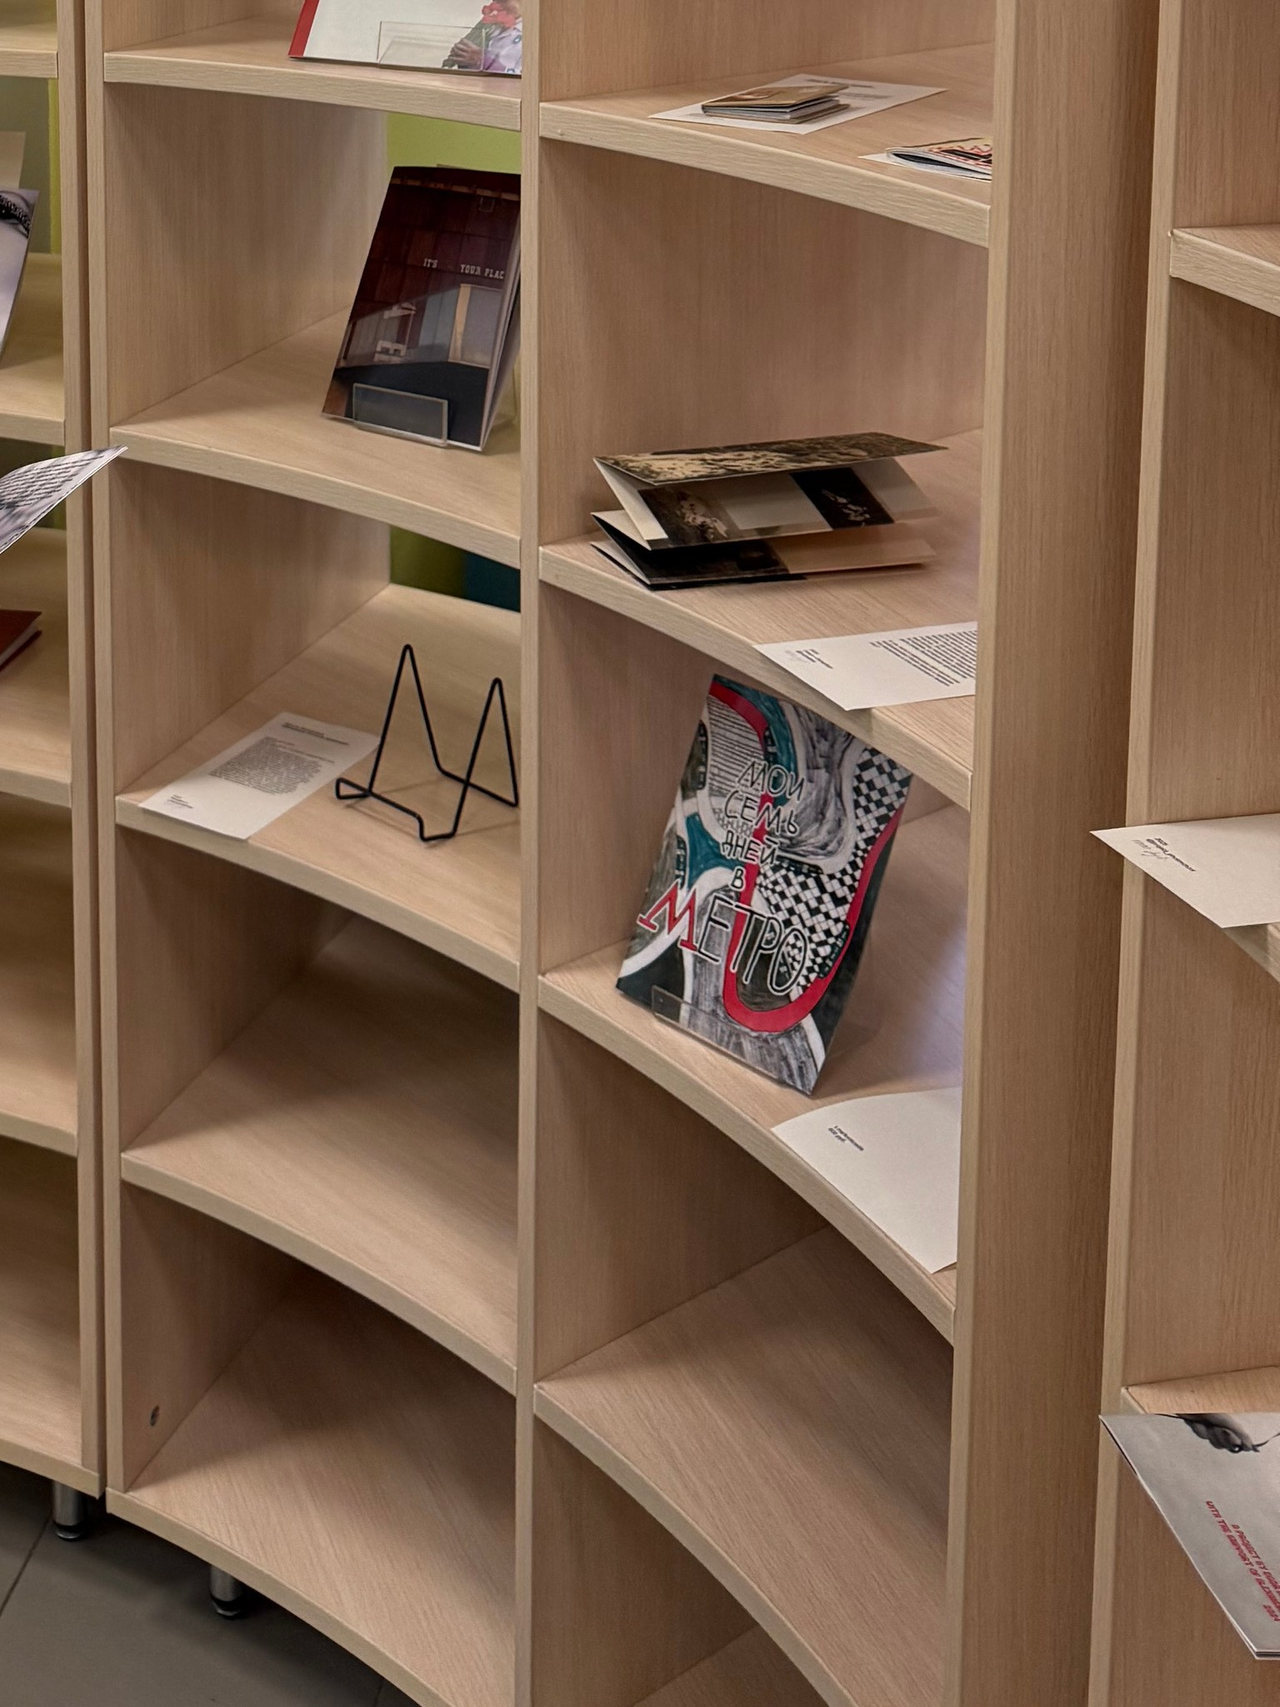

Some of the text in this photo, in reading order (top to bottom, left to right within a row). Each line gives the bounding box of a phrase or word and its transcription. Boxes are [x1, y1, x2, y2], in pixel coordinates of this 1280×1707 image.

[460, 264, 481, 275] YOUR
[737, 760, 807, 802] МОИ
[724, 789, 800, 835] СЕМЬ
[721, 830, 781, 865] ДНЕЙ
[730, 866, 746, 891] В
[636, 879, 808, 995] МЕТРО
